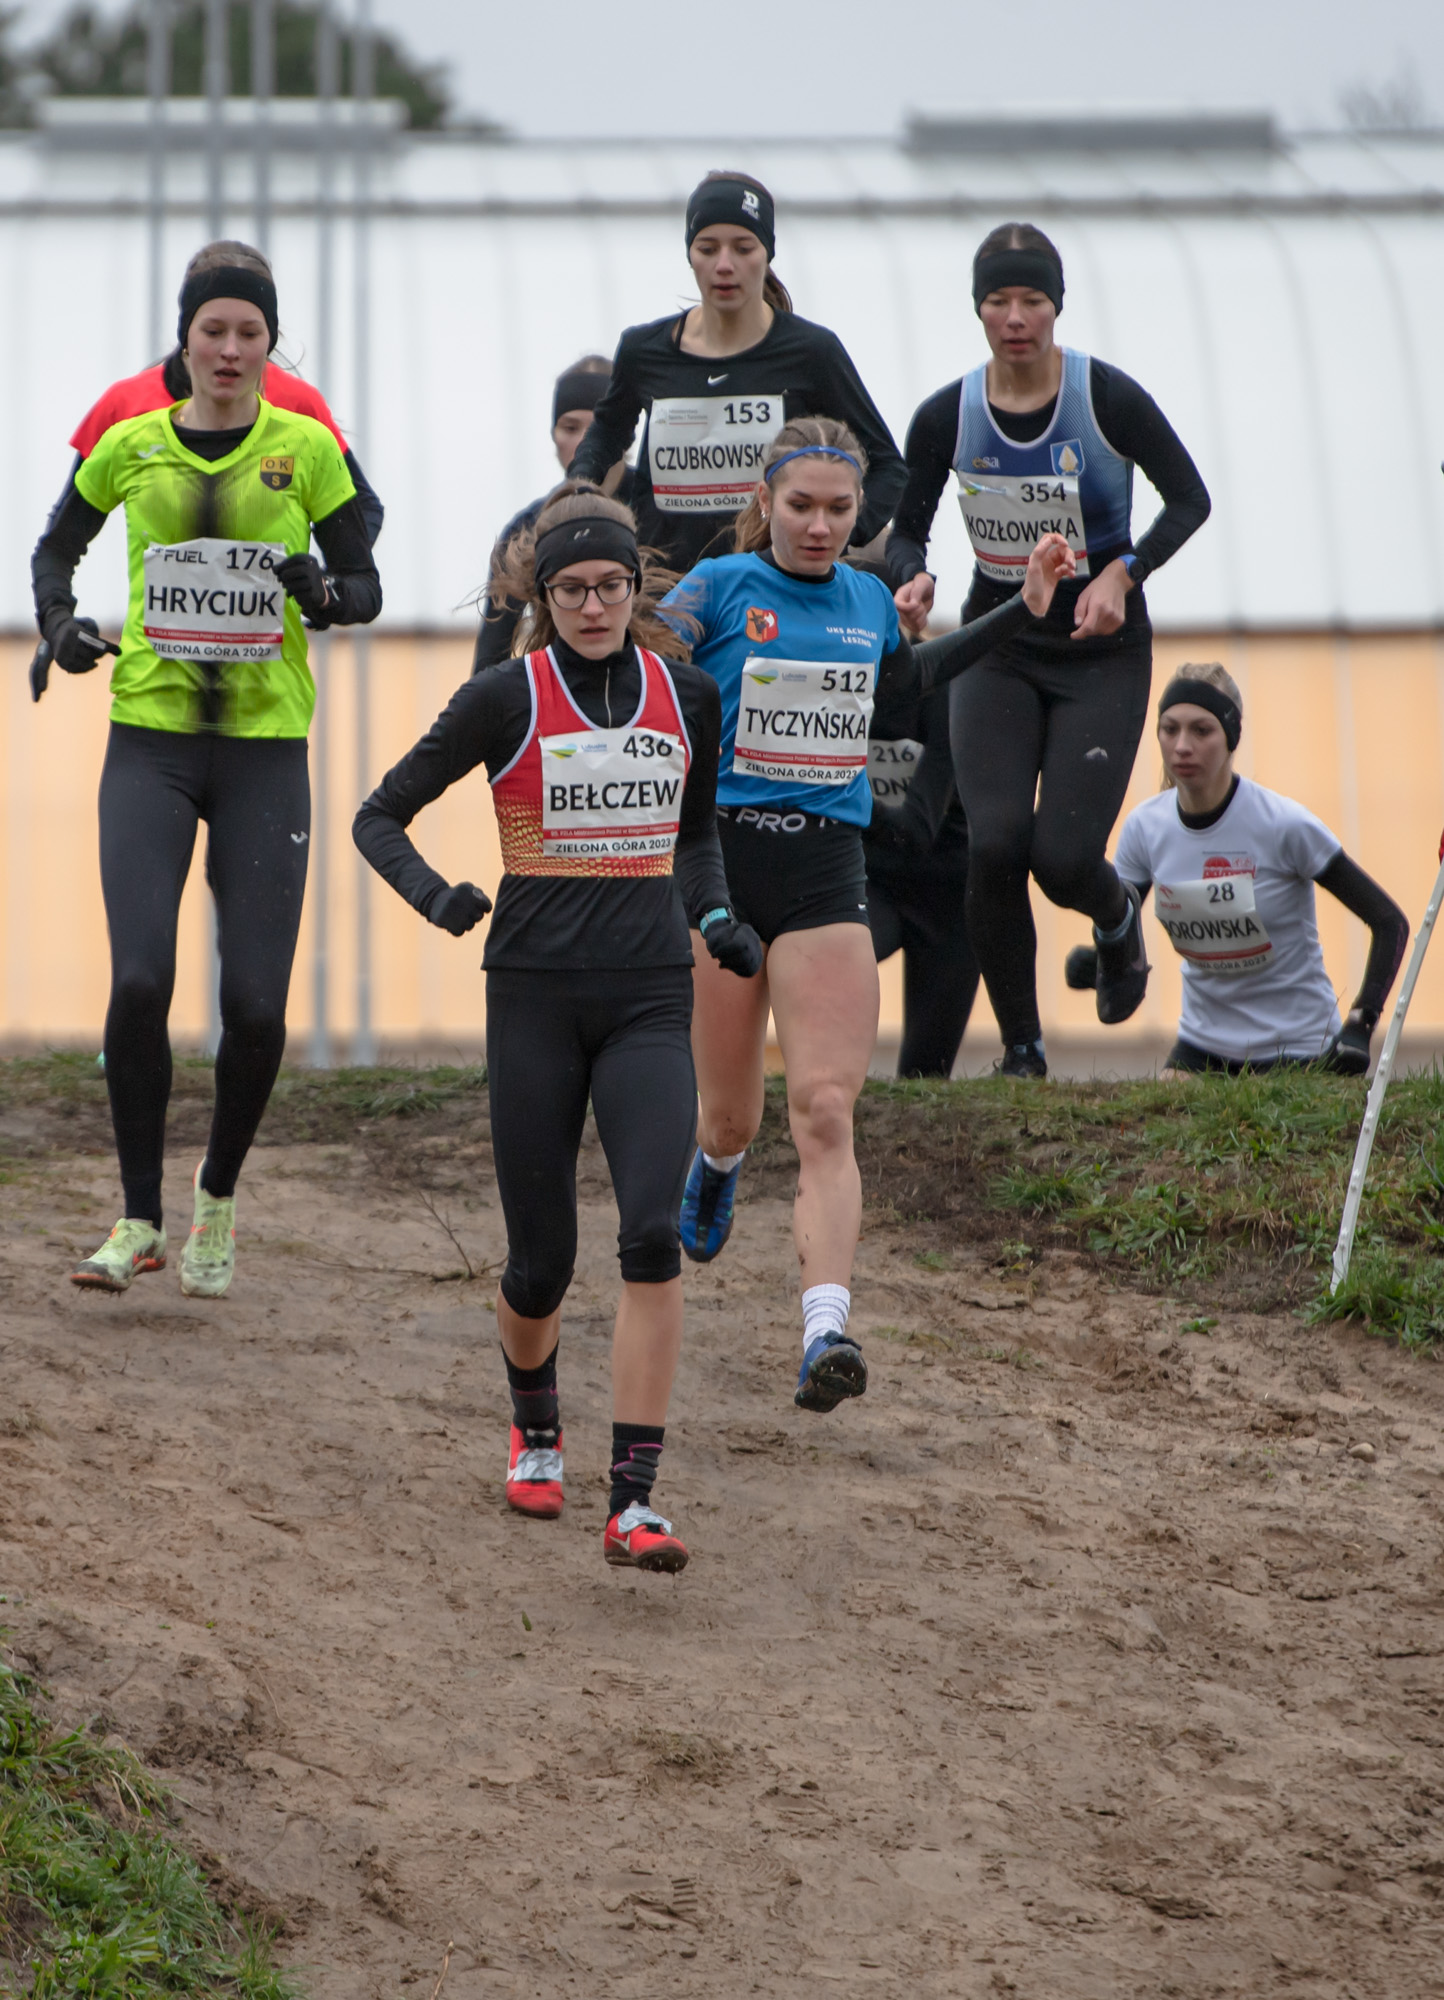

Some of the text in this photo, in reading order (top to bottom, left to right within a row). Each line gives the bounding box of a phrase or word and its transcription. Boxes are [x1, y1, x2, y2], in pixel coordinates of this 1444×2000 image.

[723, 401, 771, 425] 153
[655, 443, 766, 471] CZUBKOWSK
[271, 474, 281, 487] S
[664, 494, 748, 507] ZIELONA GÓRA
[1020, 482, 1067, 503] 354
[966, 514, 1079, 542] KOZŁOWSKA
[226, 547, 275, 570] 176
[148, 584, 279, 617] HRYCIUK
[826, 626, 844, 634] UKS
[153, 641, 201, 655] ZIELONA
[204, 644, 240, 657] GÓRA
[821, 669, 868, 693] 512
[745, 706, 867, 740] TYCZYŃSKA
[622, 734, 673, 759] 436
[872, 745, 915, 763] 216
[745, 761, 858, 780] ZIELONA GÓRA 2023
[550, 778, 680, 812] BEŁCZEW
[735, 807, 807, 832] PRO
[555, 837, 671, 853] ZIELONA GÓRA 2023
[1207, 882, 1235, 904] 28
